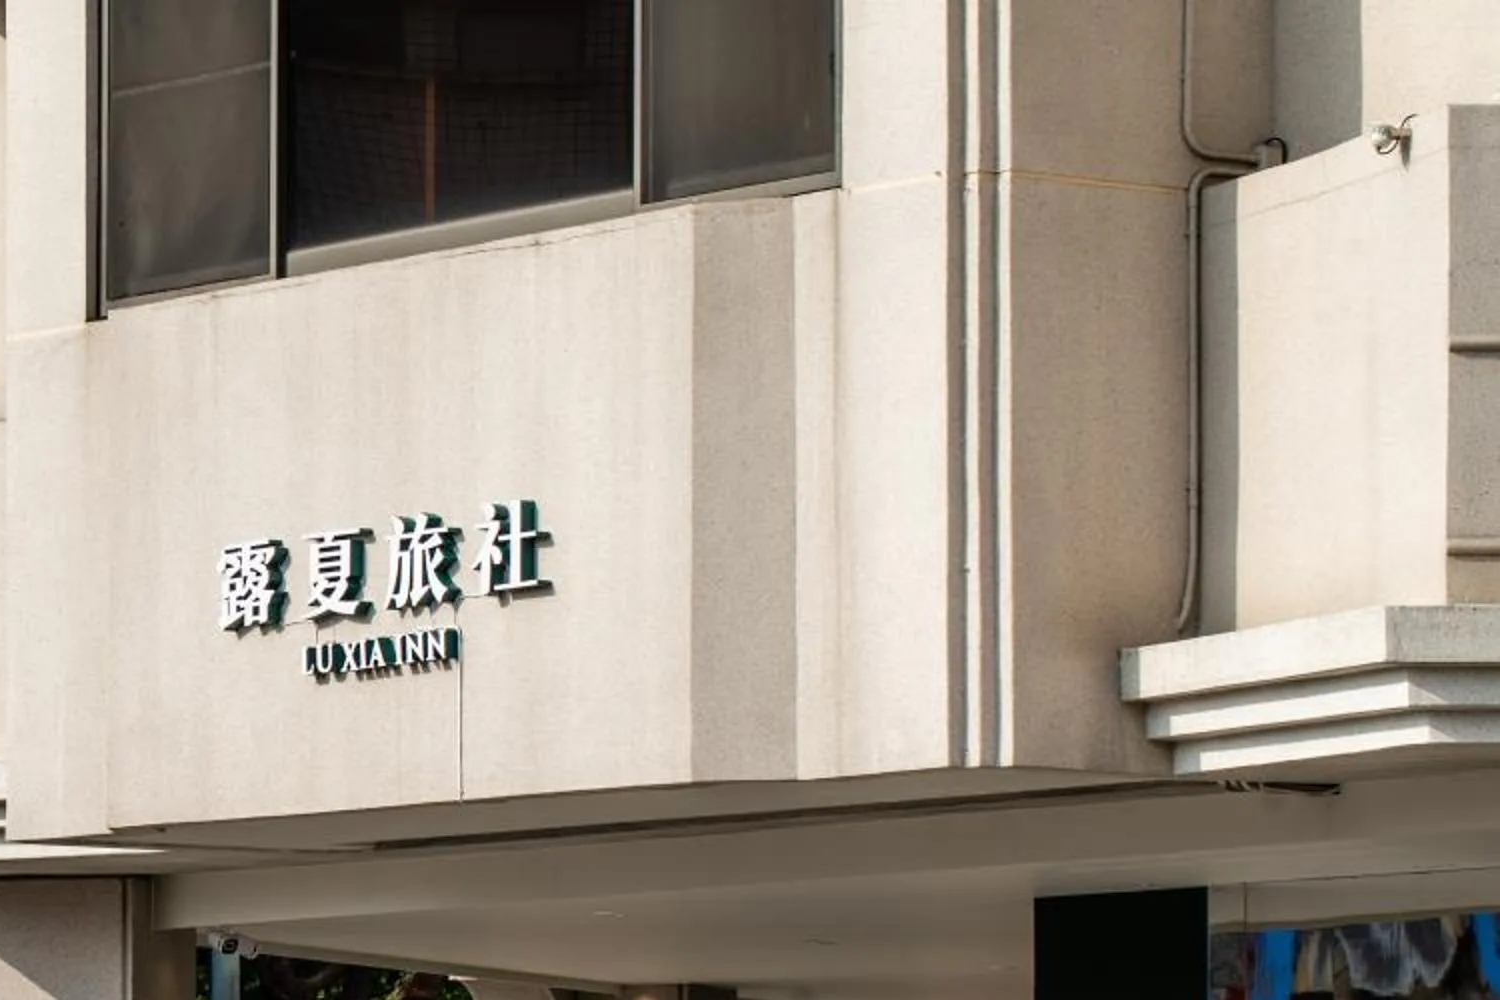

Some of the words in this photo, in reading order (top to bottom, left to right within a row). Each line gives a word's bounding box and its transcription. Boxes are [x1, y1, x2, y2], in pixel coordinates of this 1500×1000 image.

[216, 500, 546, 632] 露夏旅社
[393, 627, 448, 666] INN
